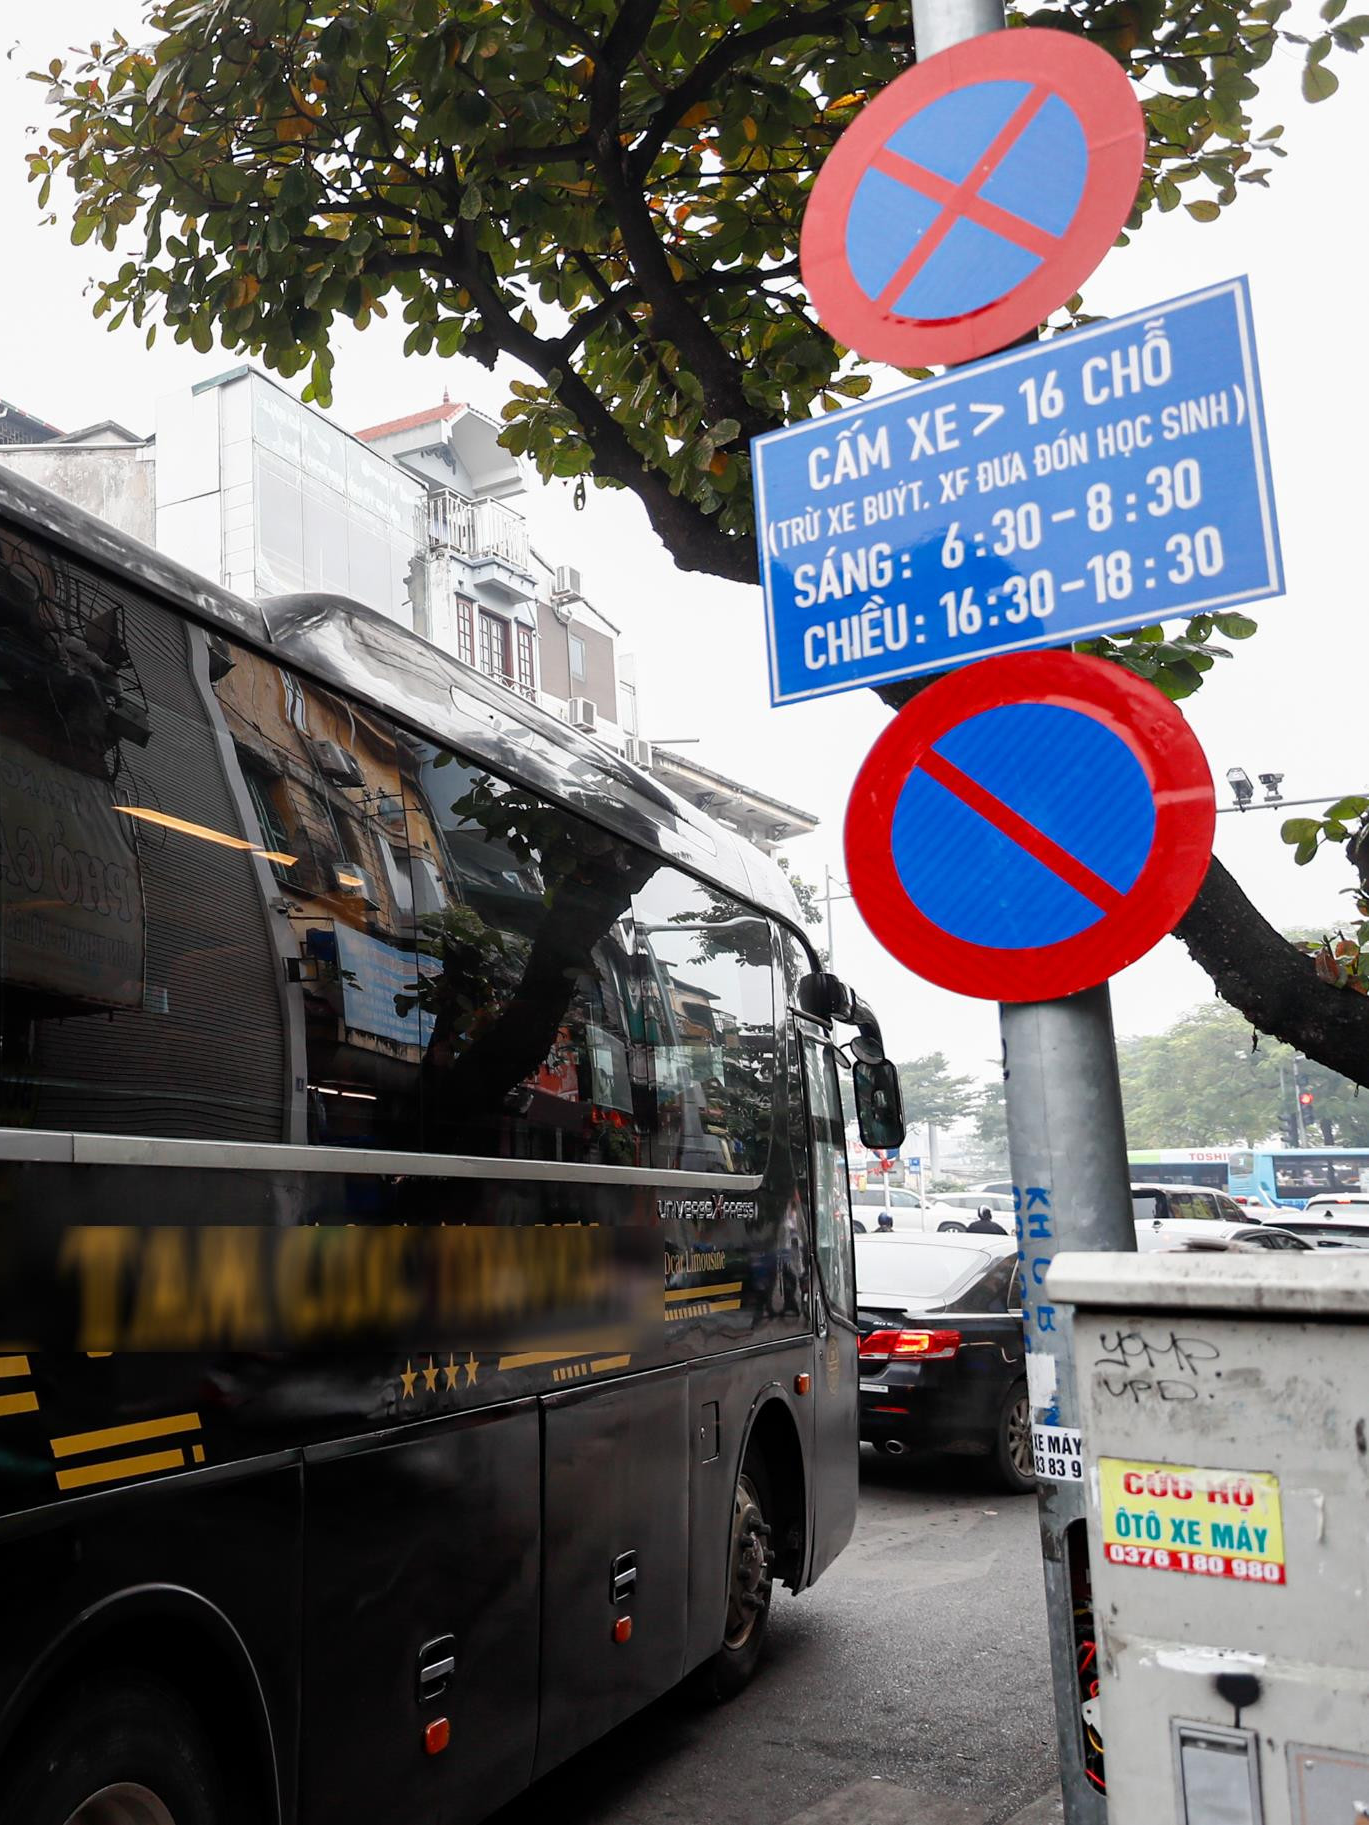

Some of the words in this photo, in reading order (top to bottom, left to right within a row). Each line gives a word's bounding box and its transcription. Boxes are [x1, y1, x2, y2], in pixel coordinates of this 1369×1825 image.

[808, 419, 891, 491] CẤM
[907, 403, 960, 461] XE
[1018, 370, 1064, 425] 16
[1081, 318, 1172, 406] CHỖ
[769, 506, 821, 557] (TRỪ
[827, 502, 856, 536] XE
[976, 451, 1027, 493] ĐƯA
[1033, 428, 1089, 476] ĐÓN
[1097, 415, 1153, 457] HỌC
[1161, 383, 1245, 440] SINH)
[793, 546, 912, 608] SÁNG:
[803, 594, 926, 670] CHIỀU:
[1189, 1153, 1231, 1161] TOSHI
[1047, 1433, 1081, 1456] MÁY
[1048, 1458, 1066, 1477] 83
[1115, 1506, 1162, 1541] ÔTÔ
[1170, 1518, 1202, 1546] XE
[1210, 1520, 1268, 1553] MÁY
[1109, 1544, 1170, 1568] 0376
